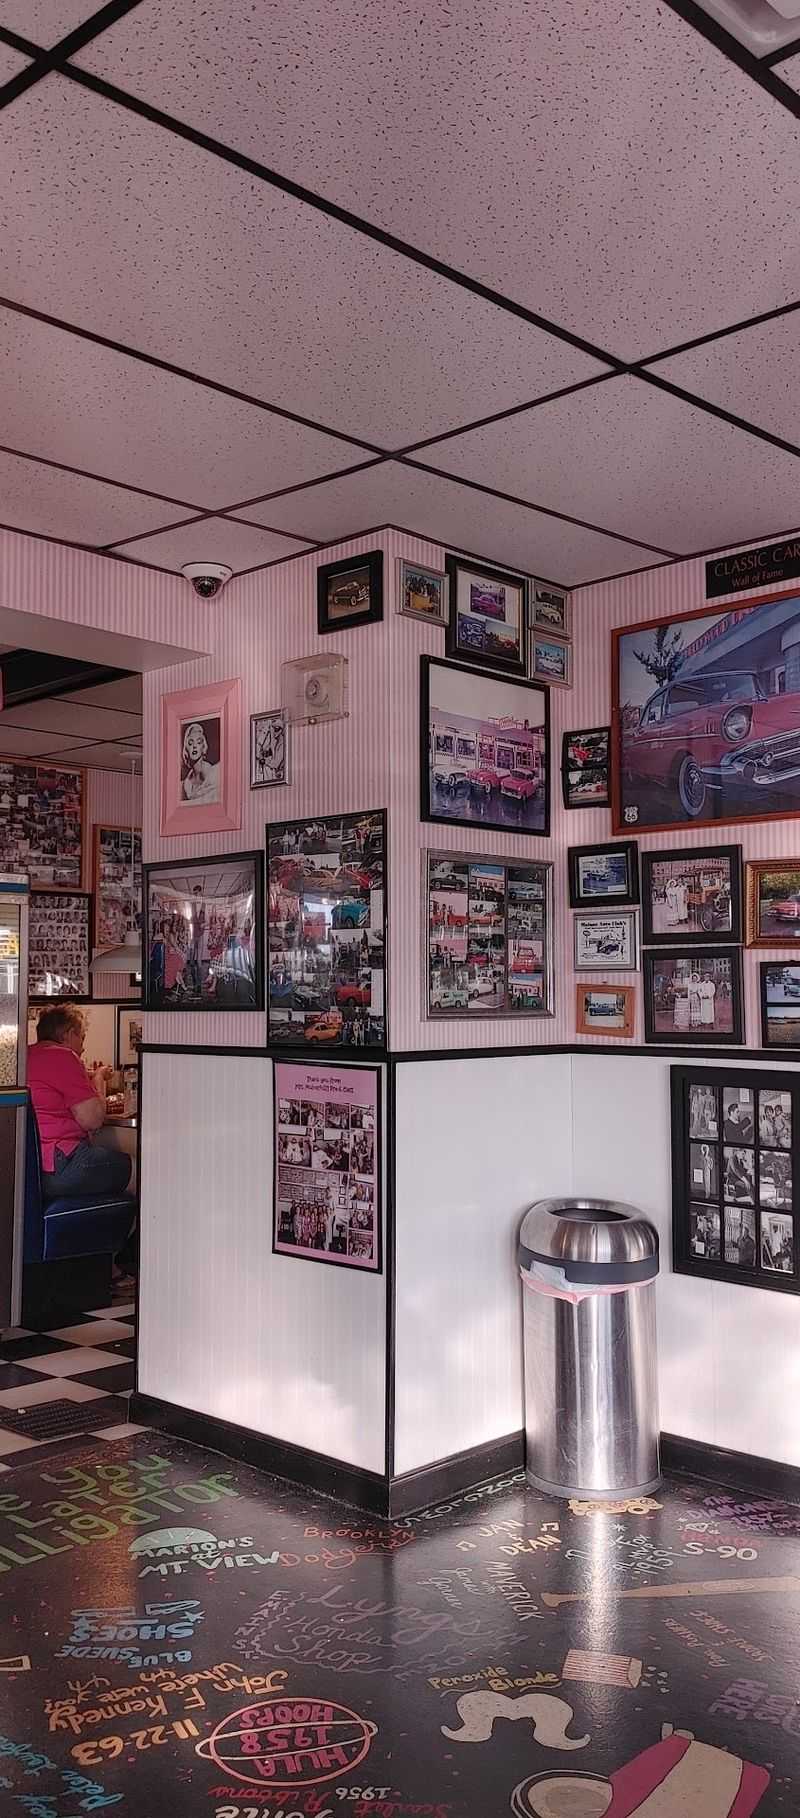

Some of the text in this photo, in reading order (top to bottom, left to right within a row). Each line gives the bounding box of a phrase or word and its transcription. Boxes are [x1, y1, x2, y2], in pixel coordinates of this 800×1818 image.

[714, 549, 768, 577] CLASSIC
[732, 569, 784, 587] Wall of Fame
[479, 1519, 525, 1538] JAN
[131, 1536, 254, 1561] MARION'S
[501, 1534, 562, 1556] DEAN
[683, 1542, 758, 1561] S-90
[197, 1551, 280, 1570] VIEW
[484, 1560, 545, 1621] MAVERICK
[69, 1621, 194, 1643] SHOES
[283, 1616, 394, 1648] Honda
[54, 1645, 193, 1669] BLUE SUEDE
[274, 1636, 383, 1671] Shop
[213, 1670, 288, 1694] John
[428, 1665, 509, 1690] Peroxide
[488, 1671, 560, 1691] Blonde
[50, 1695, 168, 1735] Kennedy
[240, 1704, 334, 1728] HOOPS
[71, 1718, 200, 1766] 11-22-63
[240, 1726, 332, 1754] 1958
[253, 1746, 349, 1777] HULA
[335, 1786, 391, 1801] 1956
